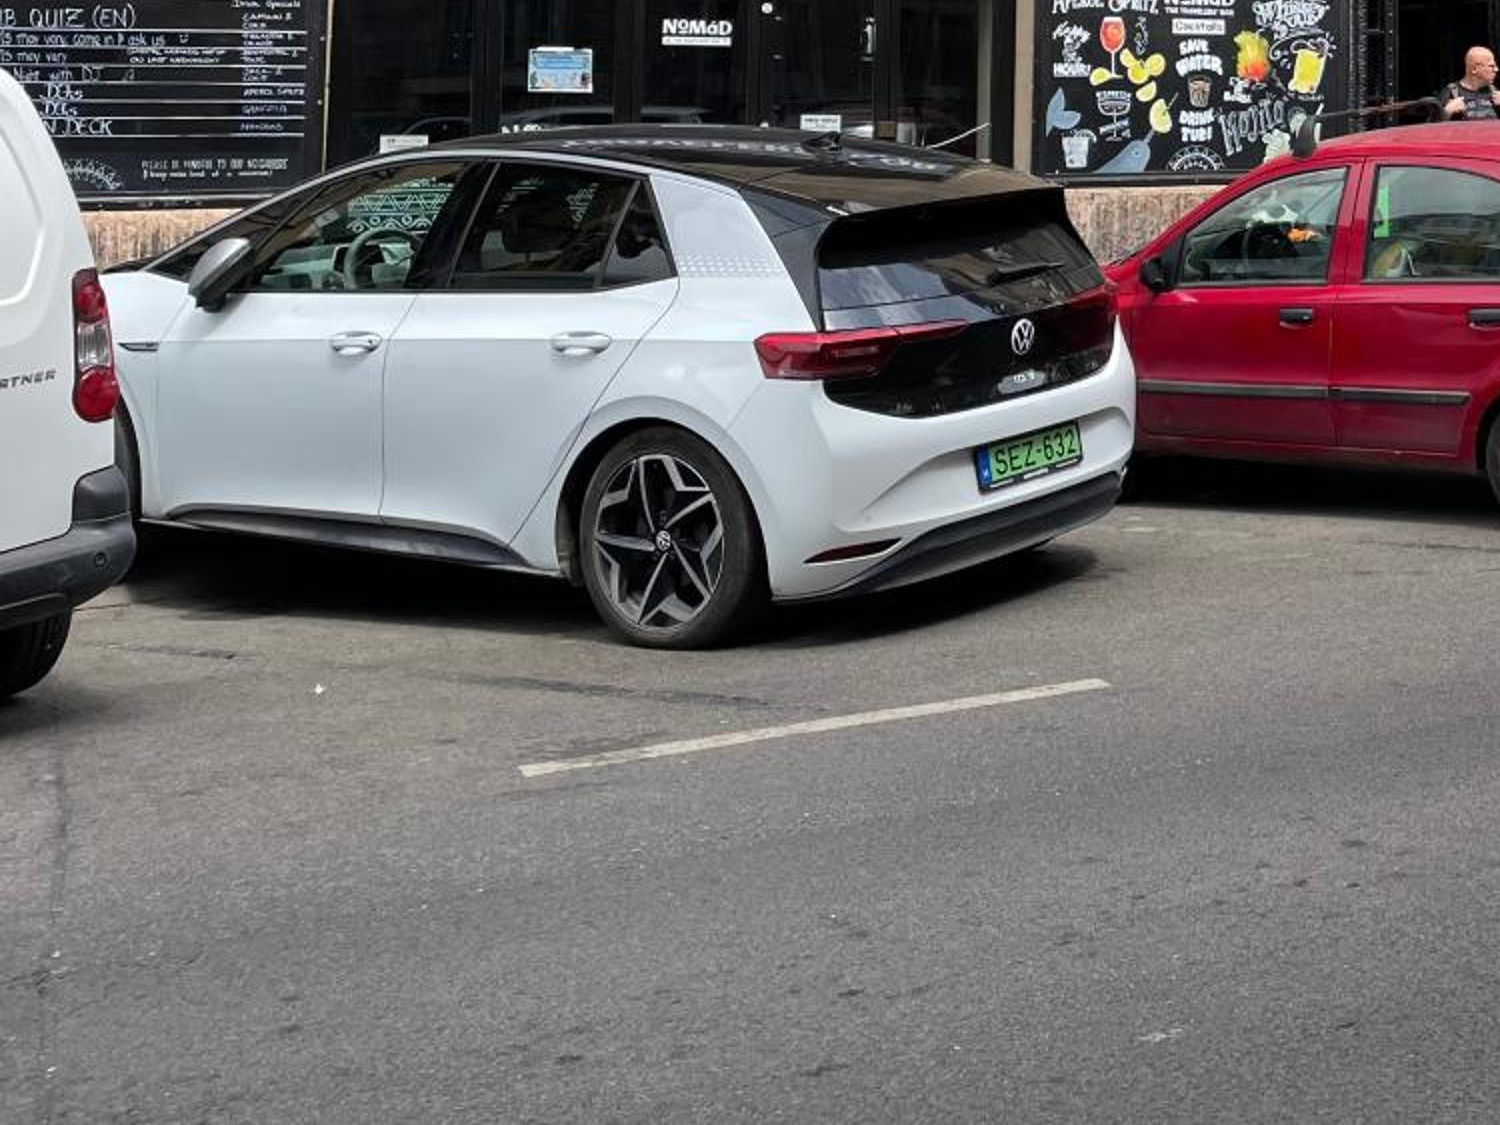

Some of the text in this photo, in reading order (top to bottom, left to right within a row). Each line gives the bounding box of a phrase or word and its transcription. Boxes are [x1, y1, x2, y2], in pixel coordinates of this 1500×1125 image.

[30, 8, 84, 27] QUIZ
[92, 3, 136, 28] (EN)
[71, 32, 102, 46] come
[127, 32, 148, 47] ask
[151, 33, 166, 47] us
[995, 428, 1078, 476] SEZ-632
